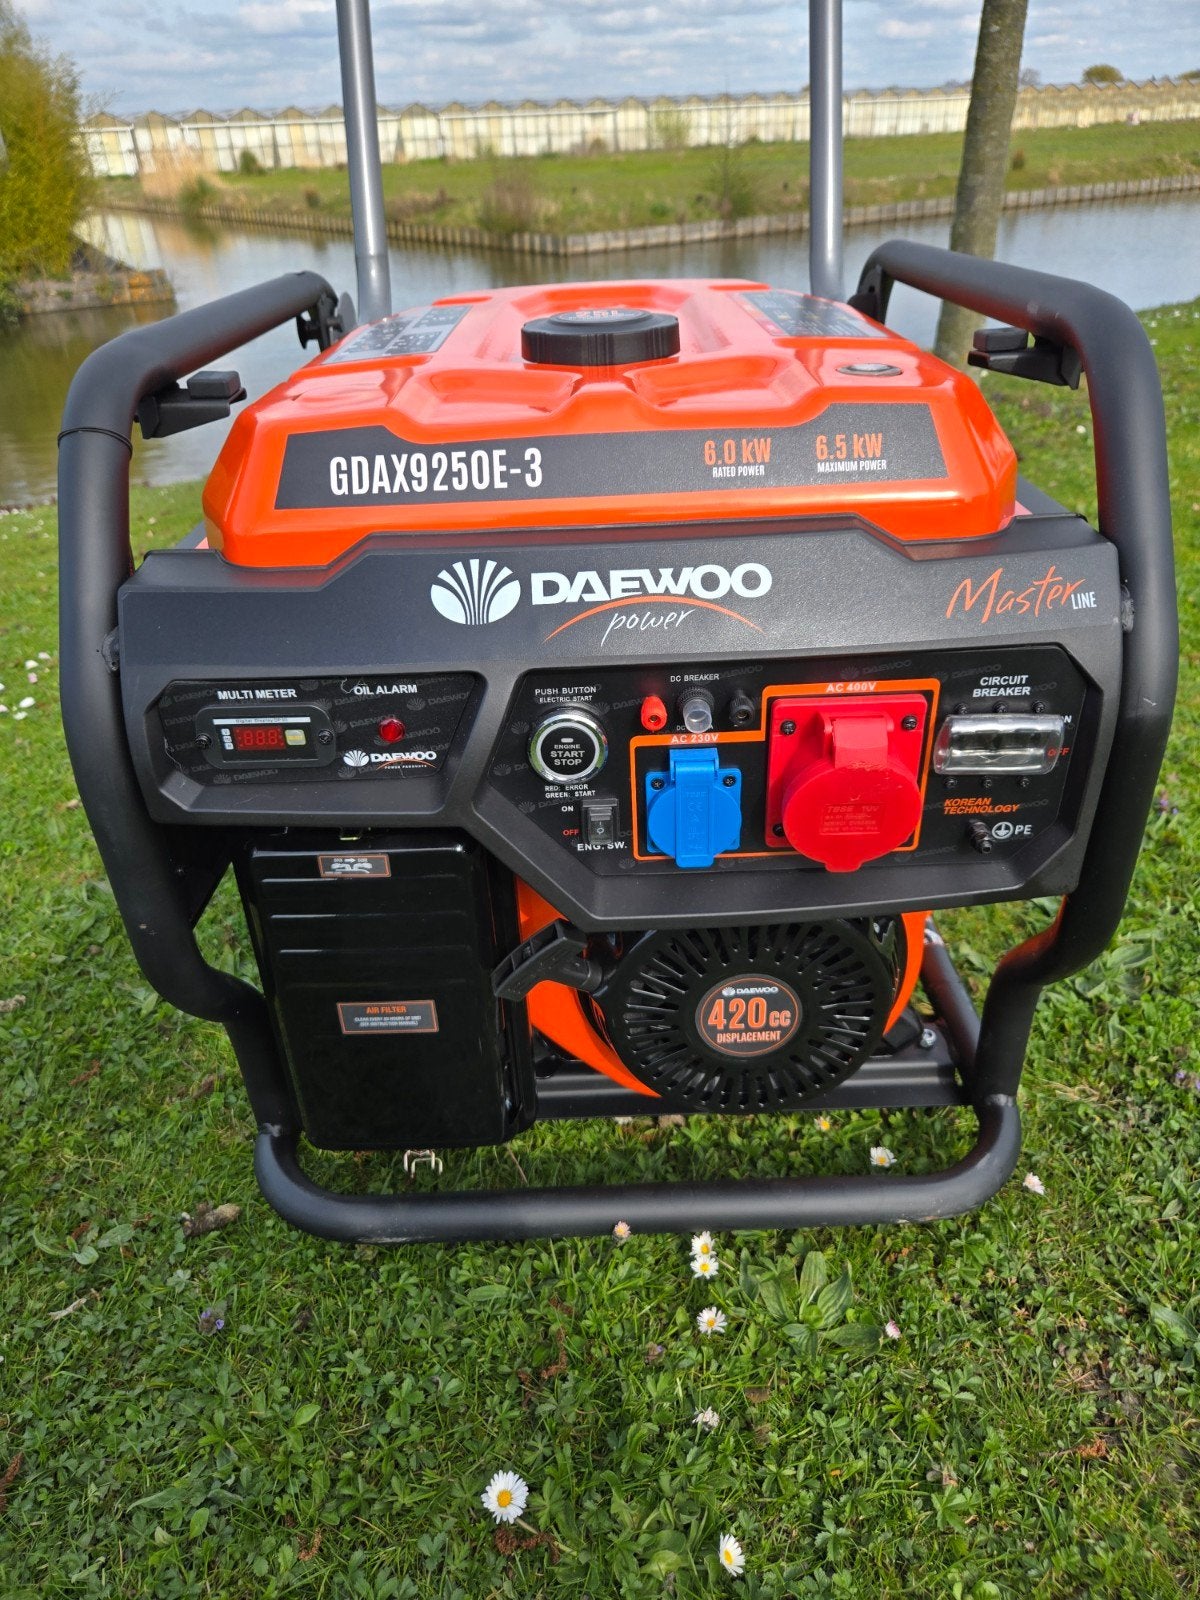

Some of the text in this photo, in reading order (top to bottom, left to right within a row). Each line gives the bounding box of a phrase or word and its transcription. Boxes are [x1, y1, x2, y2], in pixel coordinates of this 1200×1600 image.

[704, 437, 771, 465] 6.0 kW
[816, 432, 882, 460] 6.5 kW
[329, 447, 543, 496] GDAX9250E-3
[712, 464, 765, 478] RATED POWER
[817, 459, 887, 473] MAXIMUM POWER
[530, 562, 773, 606] DAEWOO
[945, 565, 1097, 624] Master LINE
[600, 608, 696, 648] power
[670, 673, 720, 683] DC BREAKER
[980, 674, 1029, 686] CIRCUIT
[354, 684, 417, 695] OIL ALARM
[535, 686, 597, 696] PUSH BUTTON
[826, 682, 877, 693] AC 400V
[972, 686, 1031, 698] BREAKER
[217, 690, 253, 700] MULTI
[255, 688, 297, 699] METER
[671, 733, 720, 744] AC 230V
[370, 751, 437, 763] DAEWOO
[550, 750, 585, 758] START
[554, 758, 582, 766] STOP
[565, 783, 588, 791] ERROR
[545, 791, 571, 799] GREEN:
[944, 797, 992, 807] KOREAN
[943, 803, 1020, 815] TECHNOLOGY
[1014, 824, 1033, 835] PE
[577, 841, 628, 851] ENG. SW.
[736, 986, 779, 995] DAEWOO
[366, 1005, 407, 1014] AIR FILTER
[707, 997, 767, 1030] 420
[717, 1030, 781, 1044] DISPLACEMENT
